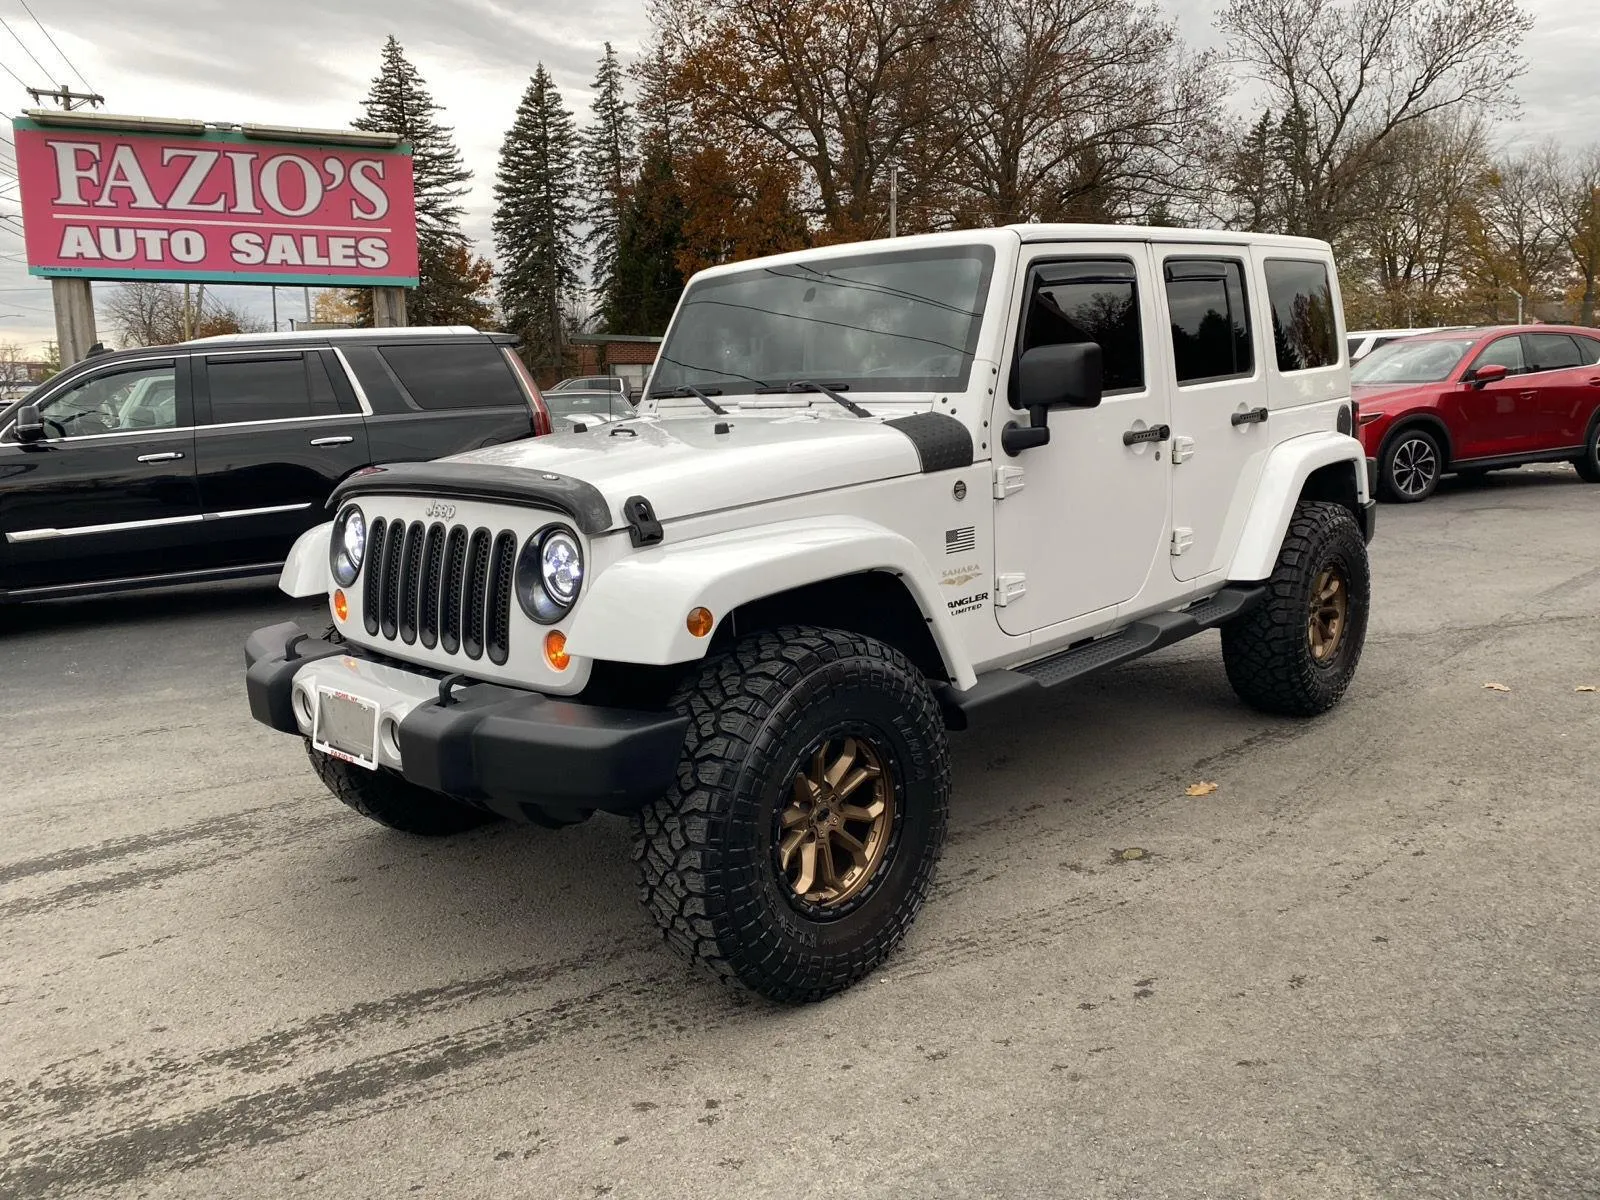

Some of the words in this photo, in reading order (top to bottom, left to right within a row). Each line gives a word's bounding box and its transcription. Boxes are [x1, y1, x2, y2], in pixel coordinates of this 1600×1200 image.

[45, 139, 390, 220] FAZIO'S
[58, 225, 206, 263] AUTO
[229, 231, 390, 269] SALES
[426, 499, 456, 522] Jeep
[942, 564, 980, 577] SAHARA
